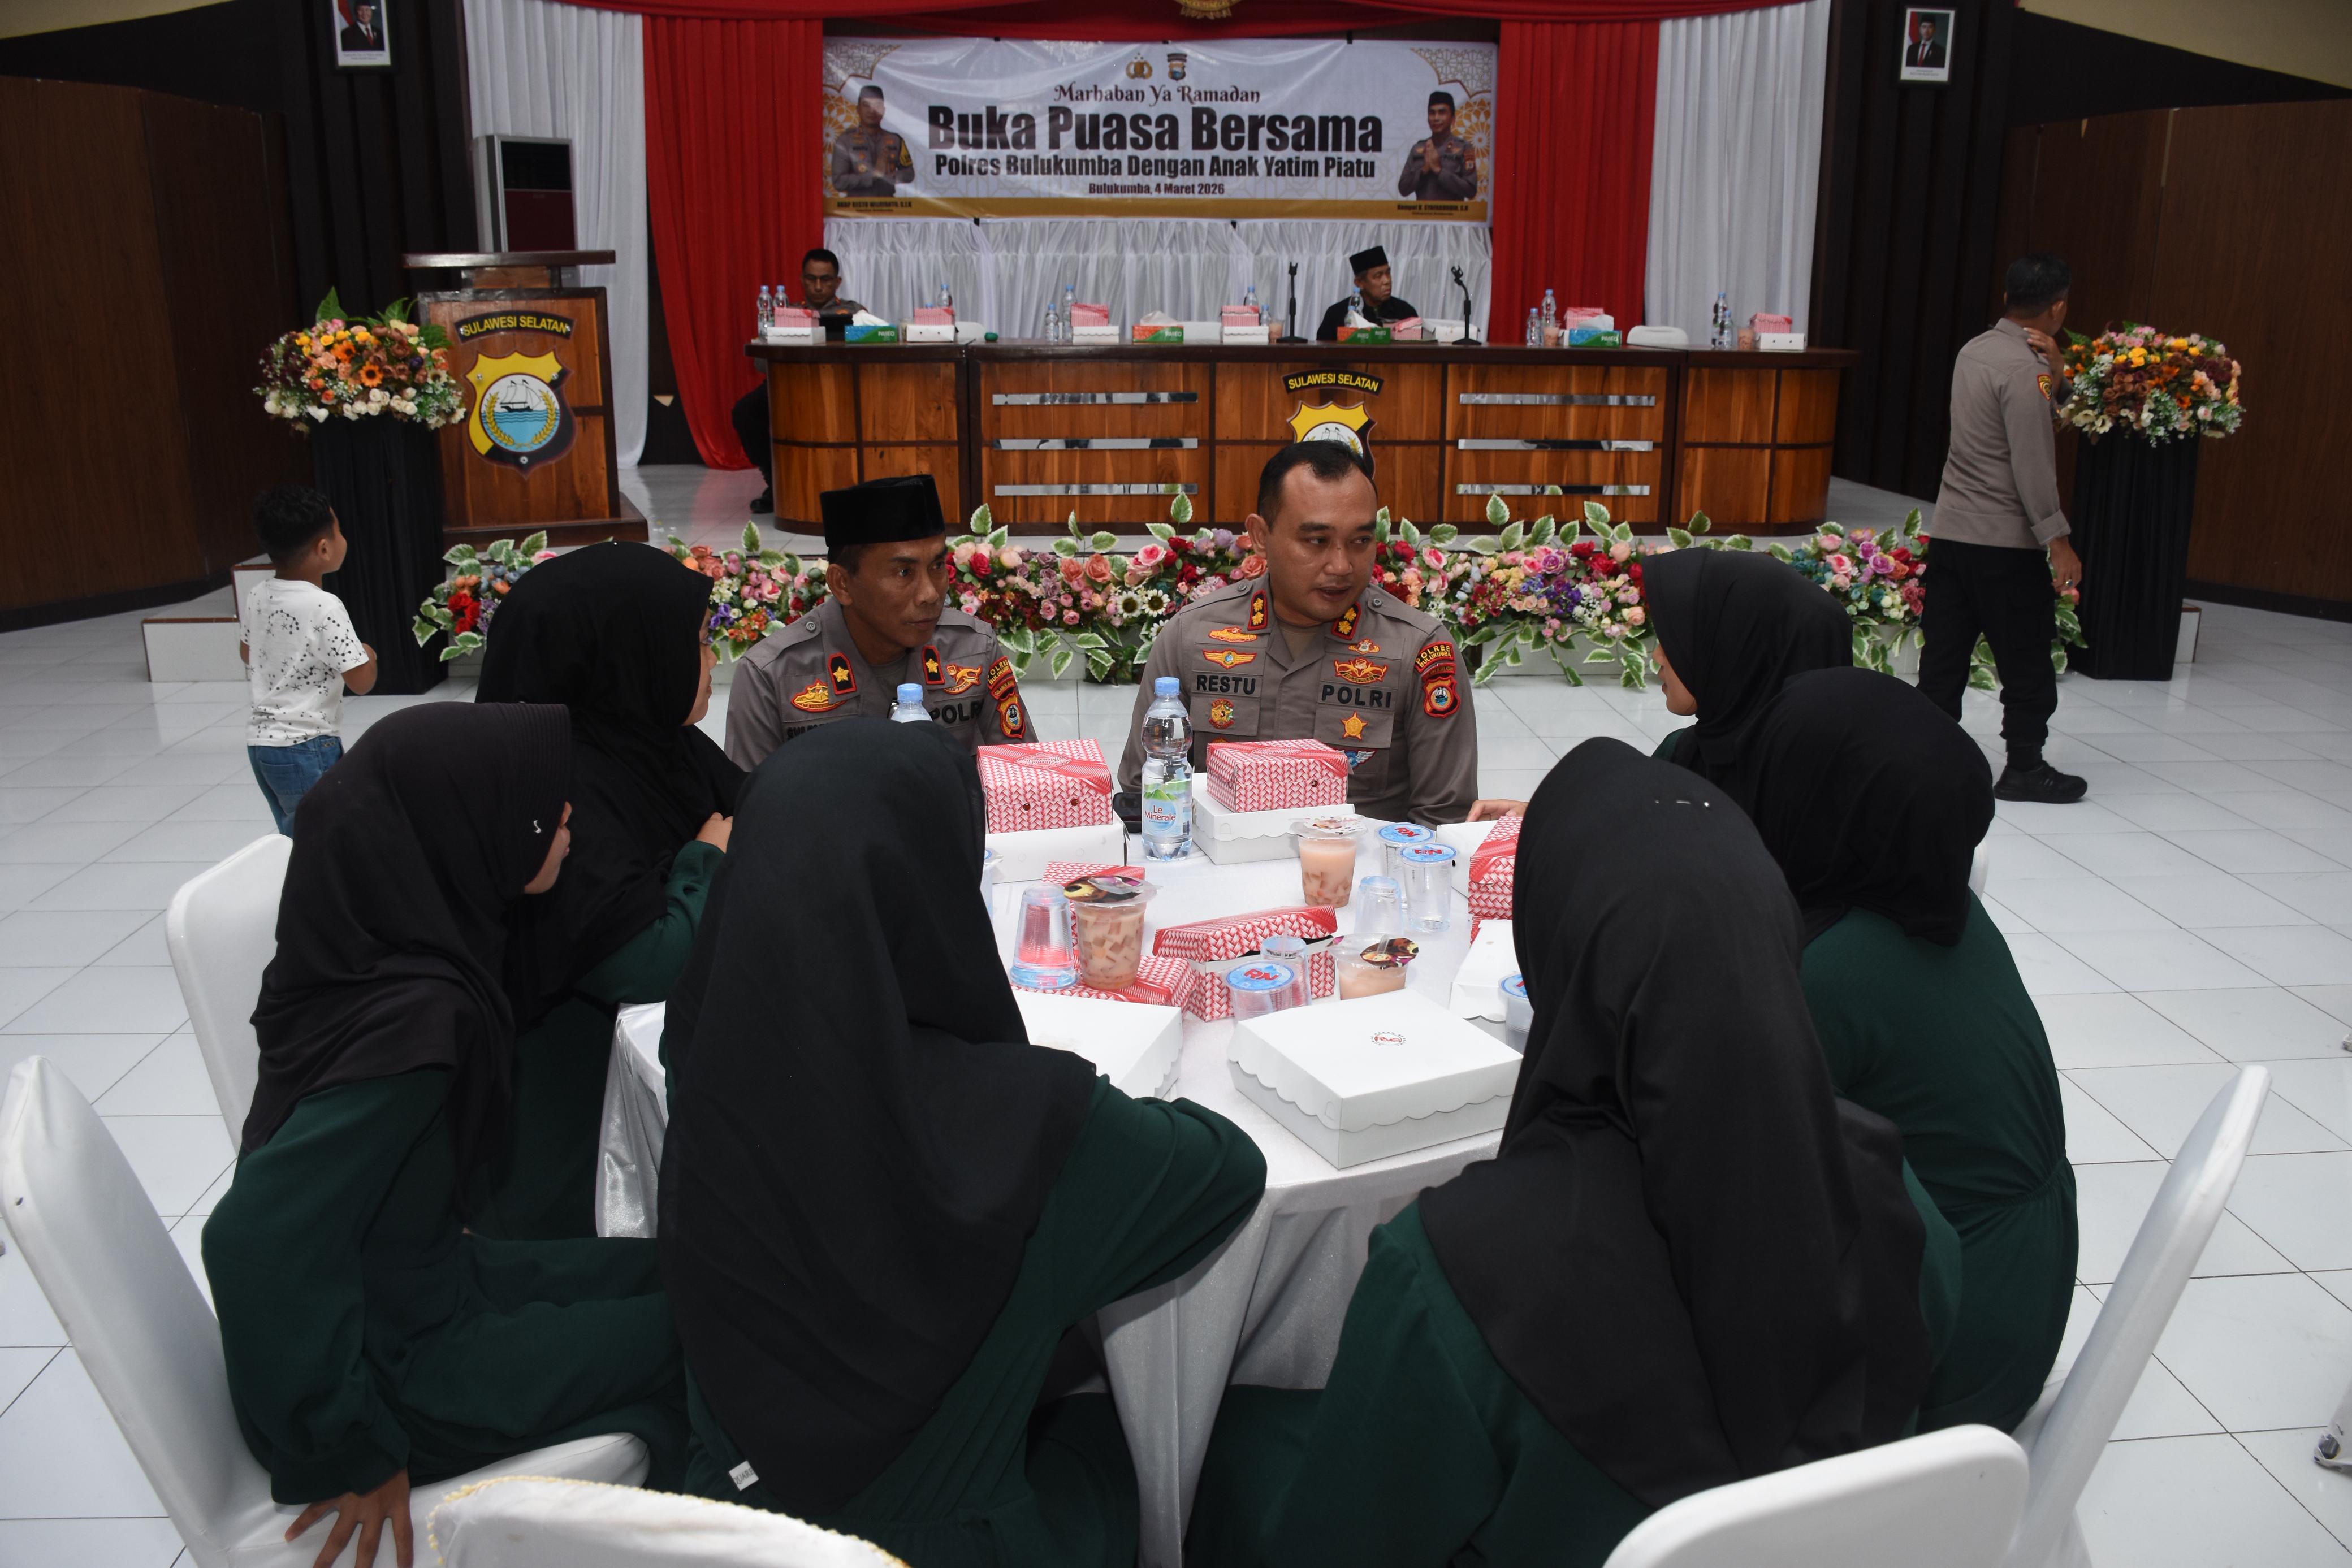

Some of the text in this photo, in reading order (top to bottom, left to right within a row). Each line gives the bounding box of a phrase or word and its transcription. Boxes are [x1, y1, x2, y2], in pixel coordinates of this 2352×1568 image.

[1053, 82, 1260, 106] Marhaban Ya Ramadan
[928, 105, 1382, 152] Buka Puasa Bersama
[936, 154, 1375, 179] Polres Bulukumba Dengan Anak Yatim Piatu
[1089, 183, 1225, 195] Bulukumba, 4 Maret 2026
[463, 315, 567, 336] SULAWESI SELATAN
[1288, 373, 1379, 392] SULAWESI SELATAN
[1416, 645, 1450, 665] POLRES
[1196, 674, 1256, 695] RESTU
[1321, 685, 1391, 708] POLRI
[1144, 810, 1176, 821] Minerale
[1153, 805, 1162, 814] Le
